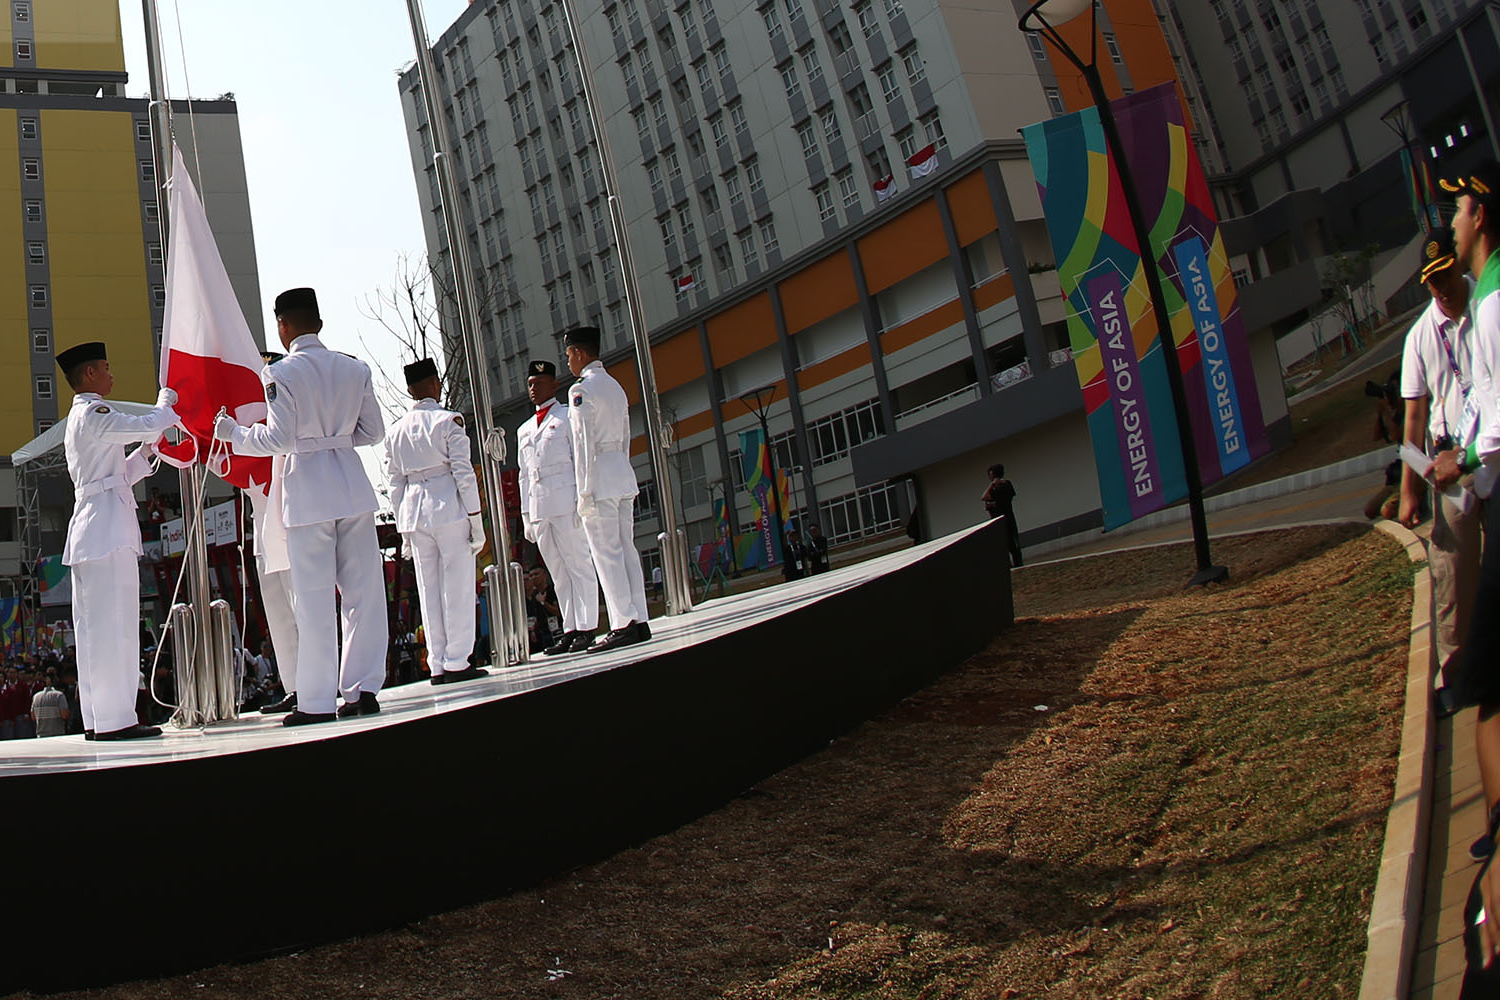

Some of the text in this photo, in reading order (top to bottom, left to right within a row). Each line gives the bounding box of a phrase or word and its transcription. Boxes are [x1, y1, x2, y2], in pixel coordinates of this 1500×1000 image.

[1100, 289, 1154, 498] ENERGY OF ASIA
[1187, 256, 1240, 456] ENERGY OF ASIA
